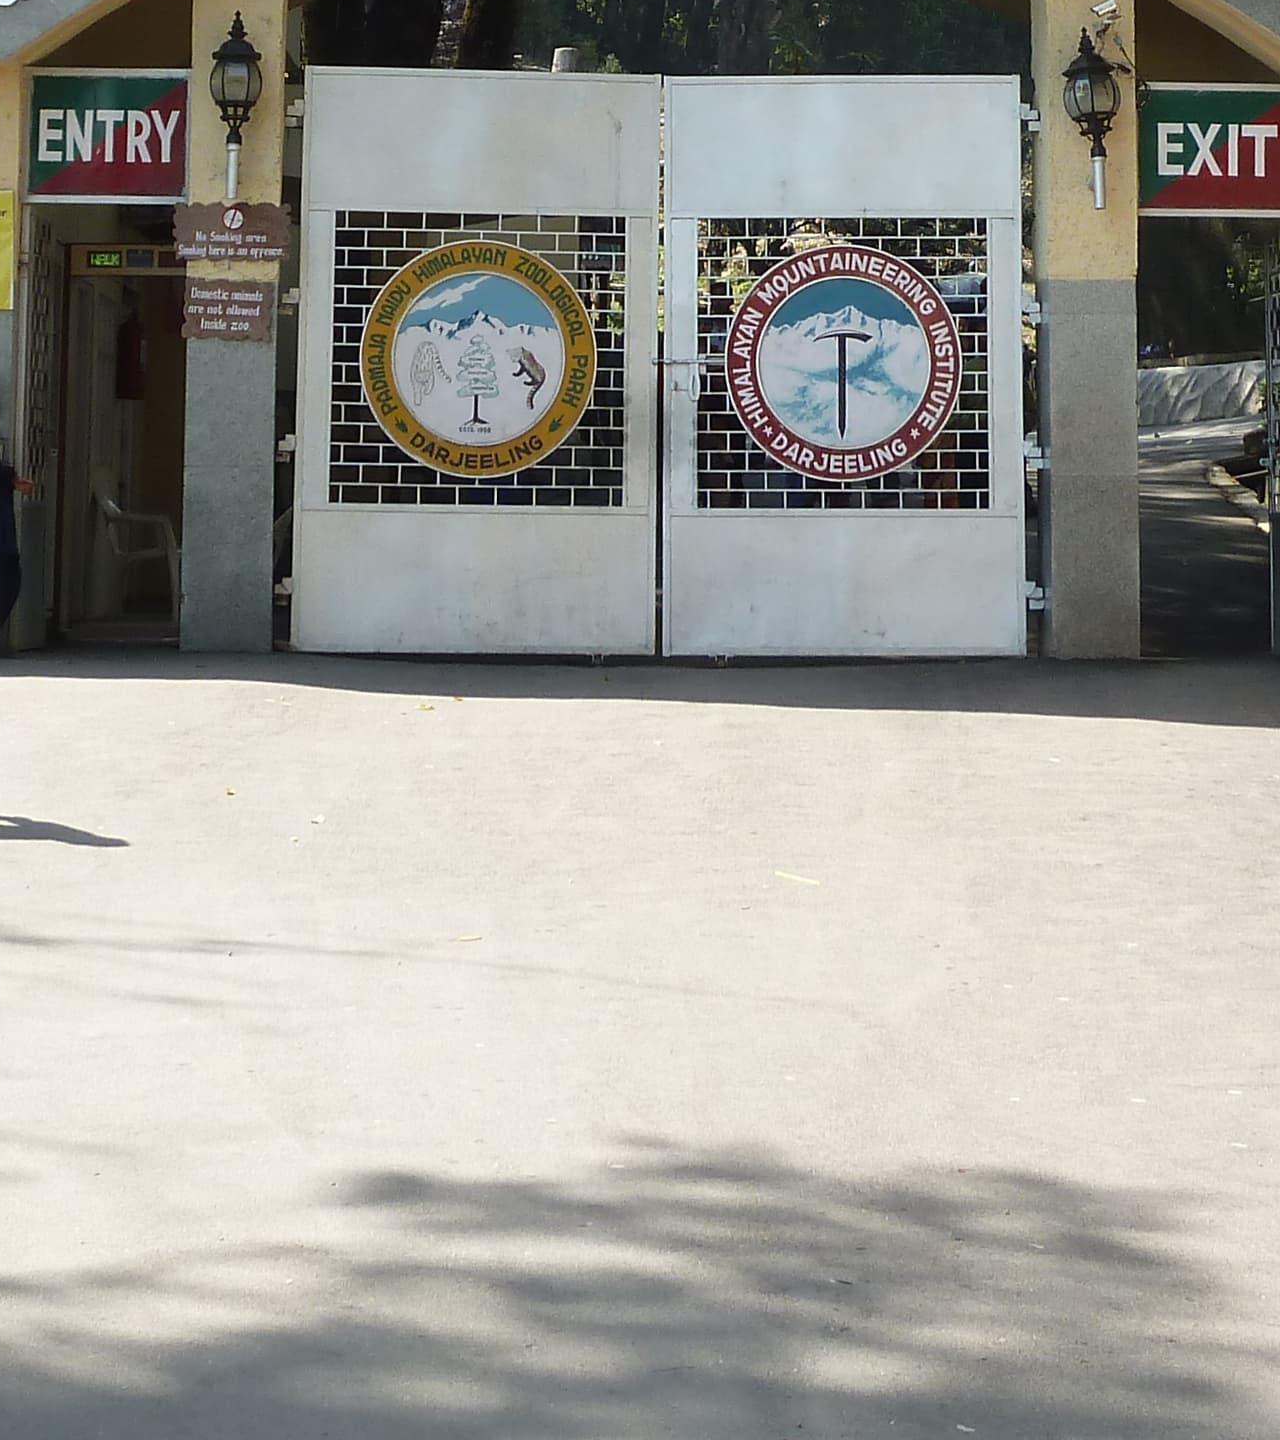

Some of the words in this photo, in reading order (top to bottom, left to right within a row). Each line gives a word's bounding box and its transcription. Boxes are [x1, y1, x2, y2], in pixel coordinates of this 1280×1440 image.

[37, 109, 180, 163] ENTRY
[1157, 122, 1278, 177] EXIT
[210, 231, 241, 244] Smoking
[412, 246, 508, 285] HIMALAYAN
[375, 283, 412, 327] NAIDU
[512, 255, 586, 346] ZOOLOGICAL
[733, 306, 768, 429] HIMALAYAN
[756, 252, 937, 316] MOUNTAINEERING
[917, 320, 954, 431] INSTITUTE
[368, 334, 399, 417] PADMAJA
[409, 431, 544, 469] DARJEELING
[771, 433, 908, 474] DARJEELING
